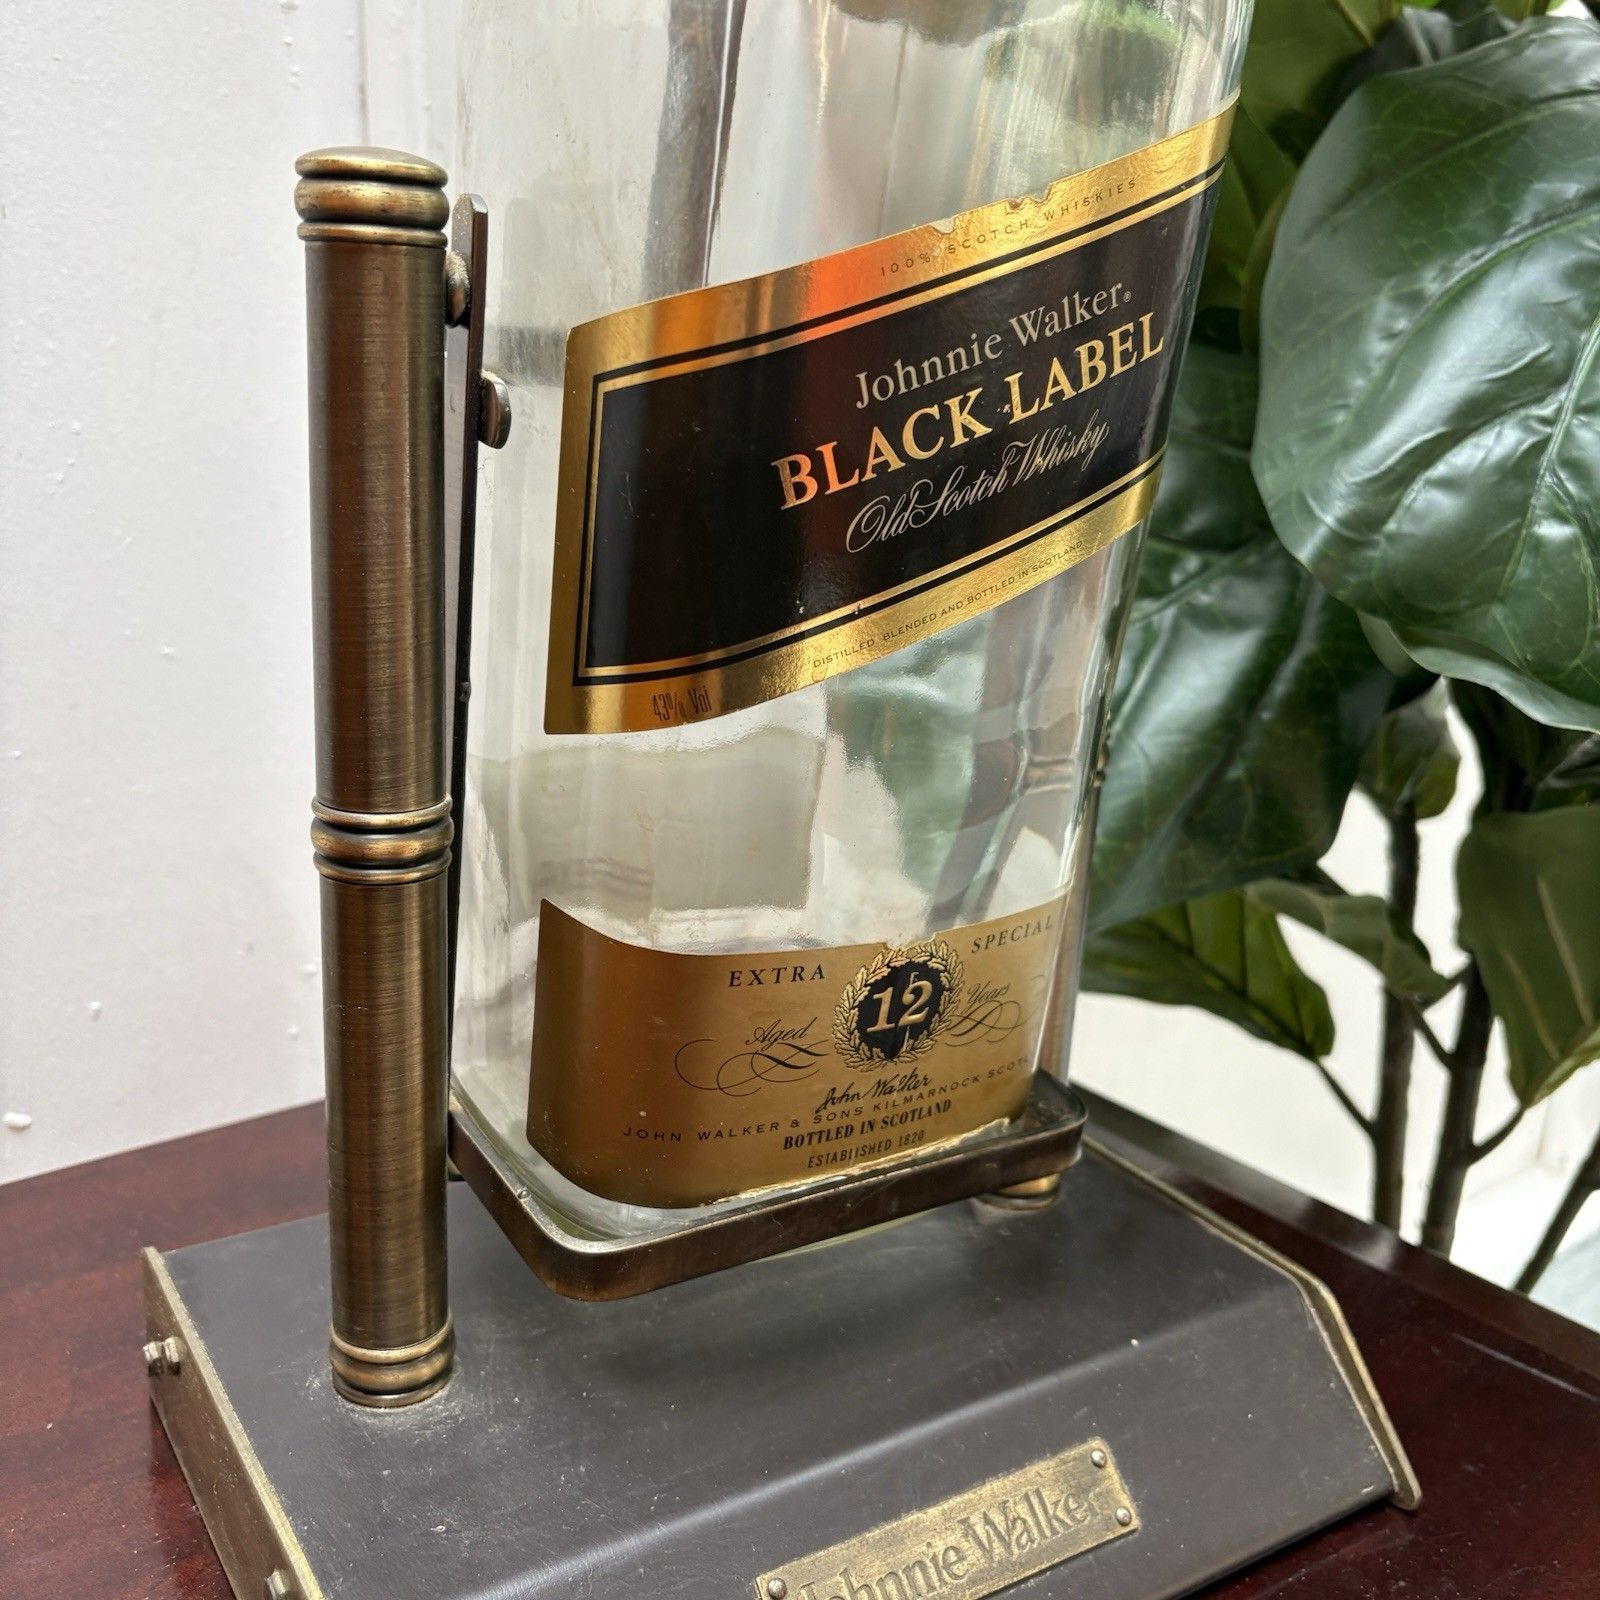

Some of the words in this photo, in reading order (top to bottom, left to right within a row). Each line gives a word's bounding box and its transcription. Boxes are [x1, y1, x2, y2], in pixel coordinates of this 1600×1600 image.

[881, 252, 931, 277] 100%
[947, 218, 1029, 255] SCOTCH
[1043, 178, 1137, 221] WHISKIES
[855, 332, 1003, 409] Johnnie
[771, 387, 992, 510] BLACK
[1003, 312, 1164, 425] LABEL
[846, 484, 924, 553] Old
[909, 448, 1019, 529] Scotch
[1008, 410, 1109, 487] Whisky
[813, 639, 875, 668] DISTILLED
[882, 613, 937, 641] BLENDED
[940, 601, 964, 617] AND
[966, 577, 1015, 605] BOTTLED
[1018, 568, 1029, 580] IN
[1032, 540, 1083, 573] SCOTLAND
[653, 692, 687, 721] 43%
[728, 964, 825, 987] EXTRA
[971, 914, 1053, 953] SPECIAL
[745, 1016, 817, 1052] Aged
[866, 980, 933, 1033] 12
[963, 980, 1010, 1010] Years
[623, 1127, 681, 1142] JOHN
[697, 1121, 780, 1141] WALKER
[790, 1119, 800, 1128] &
[813, 1106, 864, 1124] SONS
[873, 1074, 980, 1112] KILMARNOCK
[784, 1124, 859, 1150] BOTTLED
[860, 1117, 876, 1135] IN
[880, 1098, 952, 1129] SCOTLAND
[815, 1081, 866, 1115] John
[866, 1067, 932, 1099] Walker
[808, 1140, 892, 1168] ESTABLISHED
[898, 1130, 926, 1148] 1820
